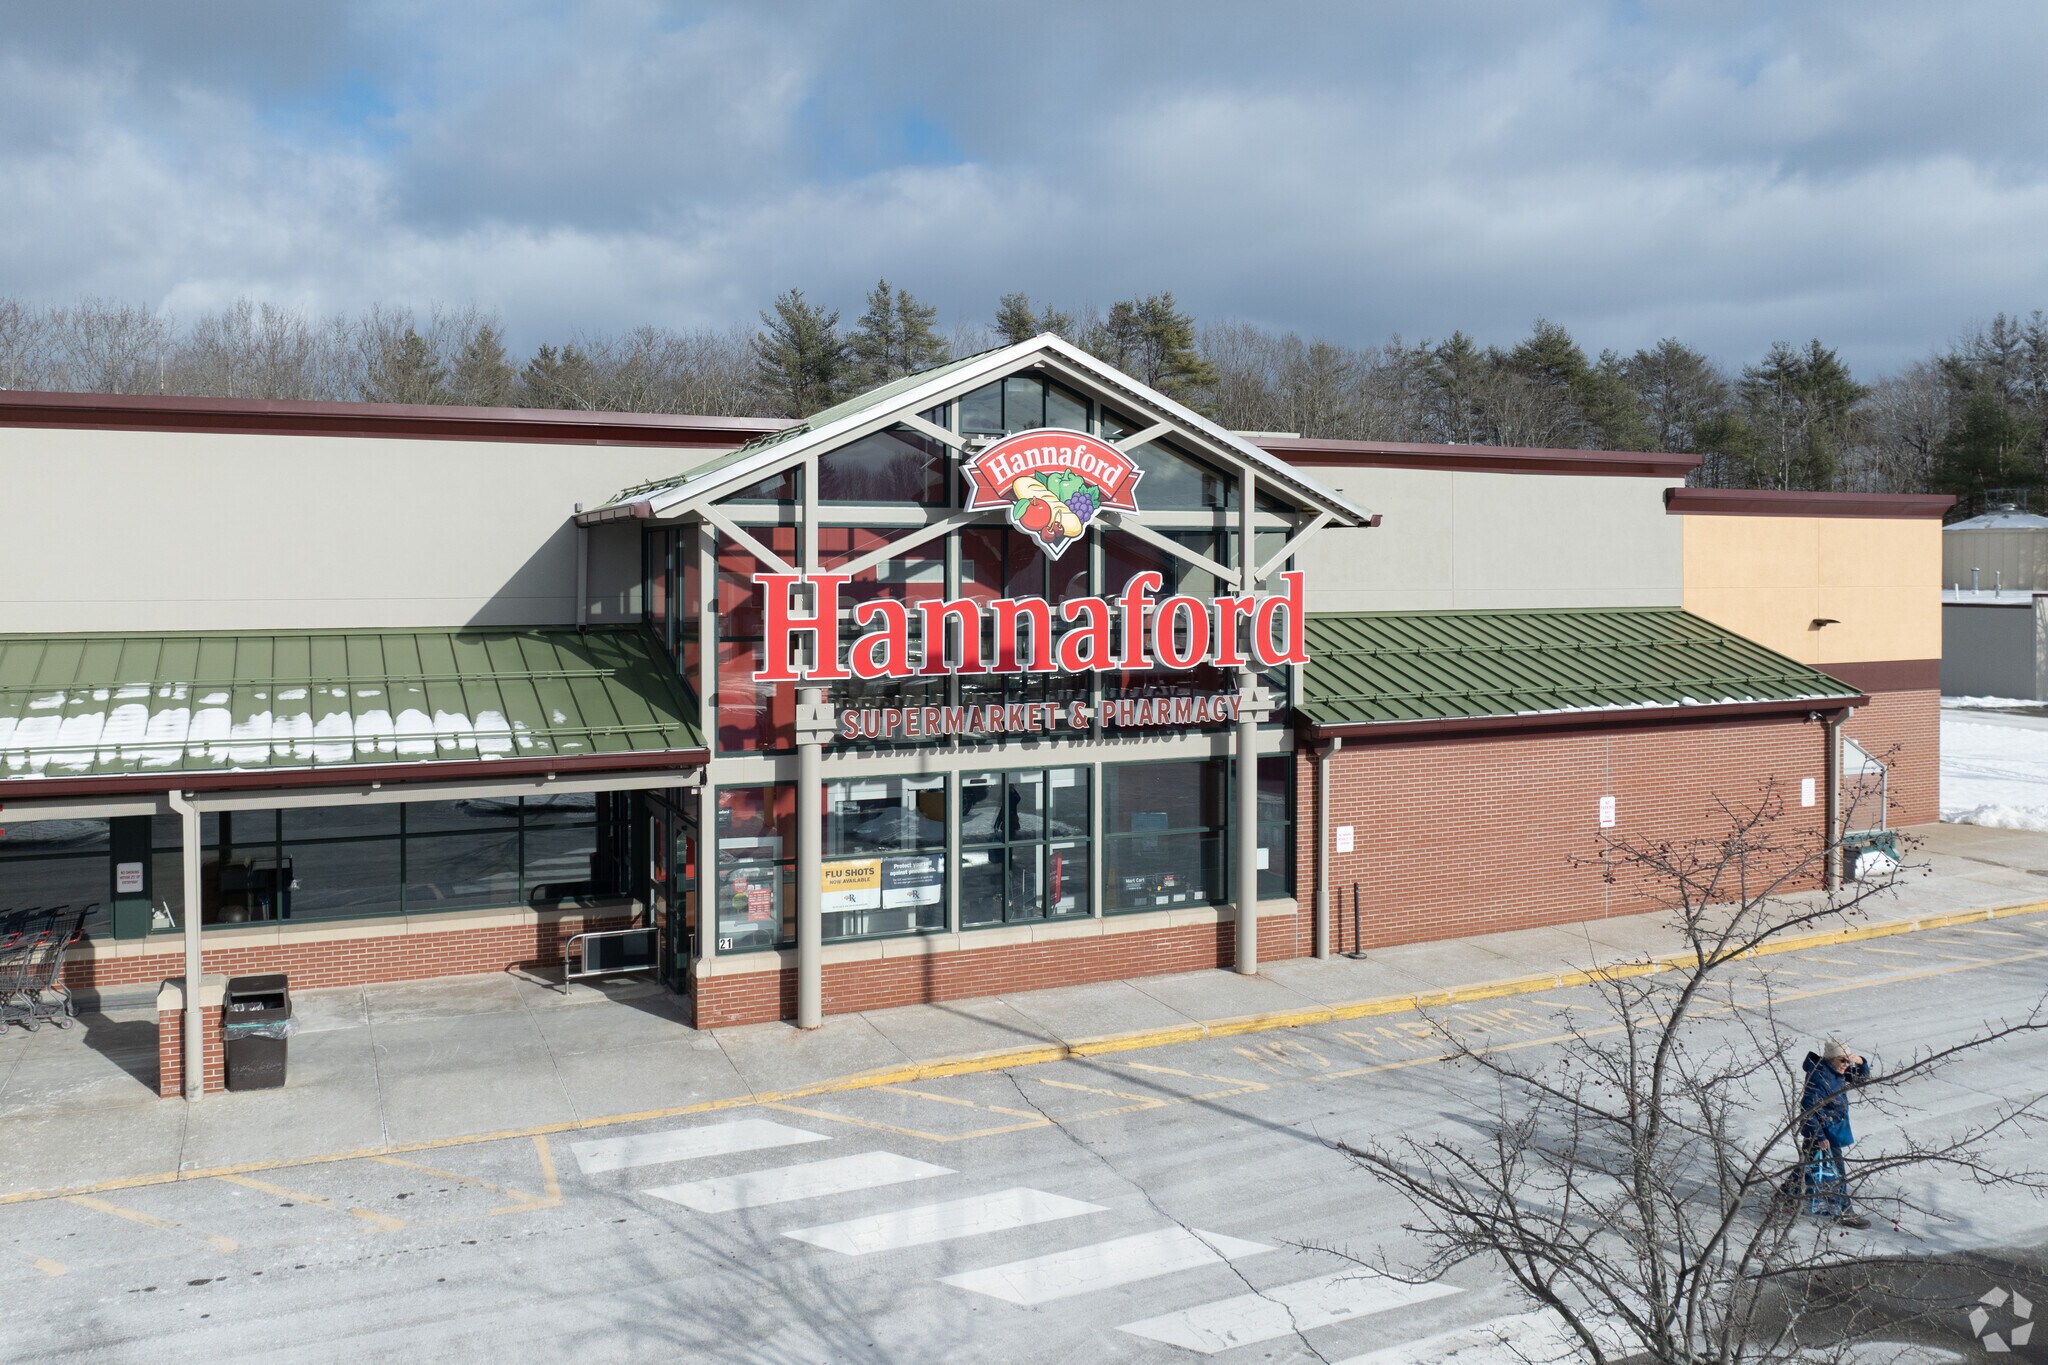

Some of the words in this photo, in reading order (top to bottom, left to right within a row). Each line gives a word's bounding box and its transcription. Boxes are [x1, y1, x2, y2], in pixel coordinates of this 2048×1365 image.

[986, 445, 1124, 488] Hannaford
[752, 570, 1310, 681] Hannaford
[842, 703, 1060, 739] SUPERMARKET
[1070, 701, 1089, 729] &
[1099, 694, 1242, 728] PHARMACY
[825, 870, 843, 879] FLU
[845, 867, 875, 877] SHOTS
[889, 869, 908, 877] against
[908, 867, 937, 876] pneuia.
[720, 939, 732, 949] 21
